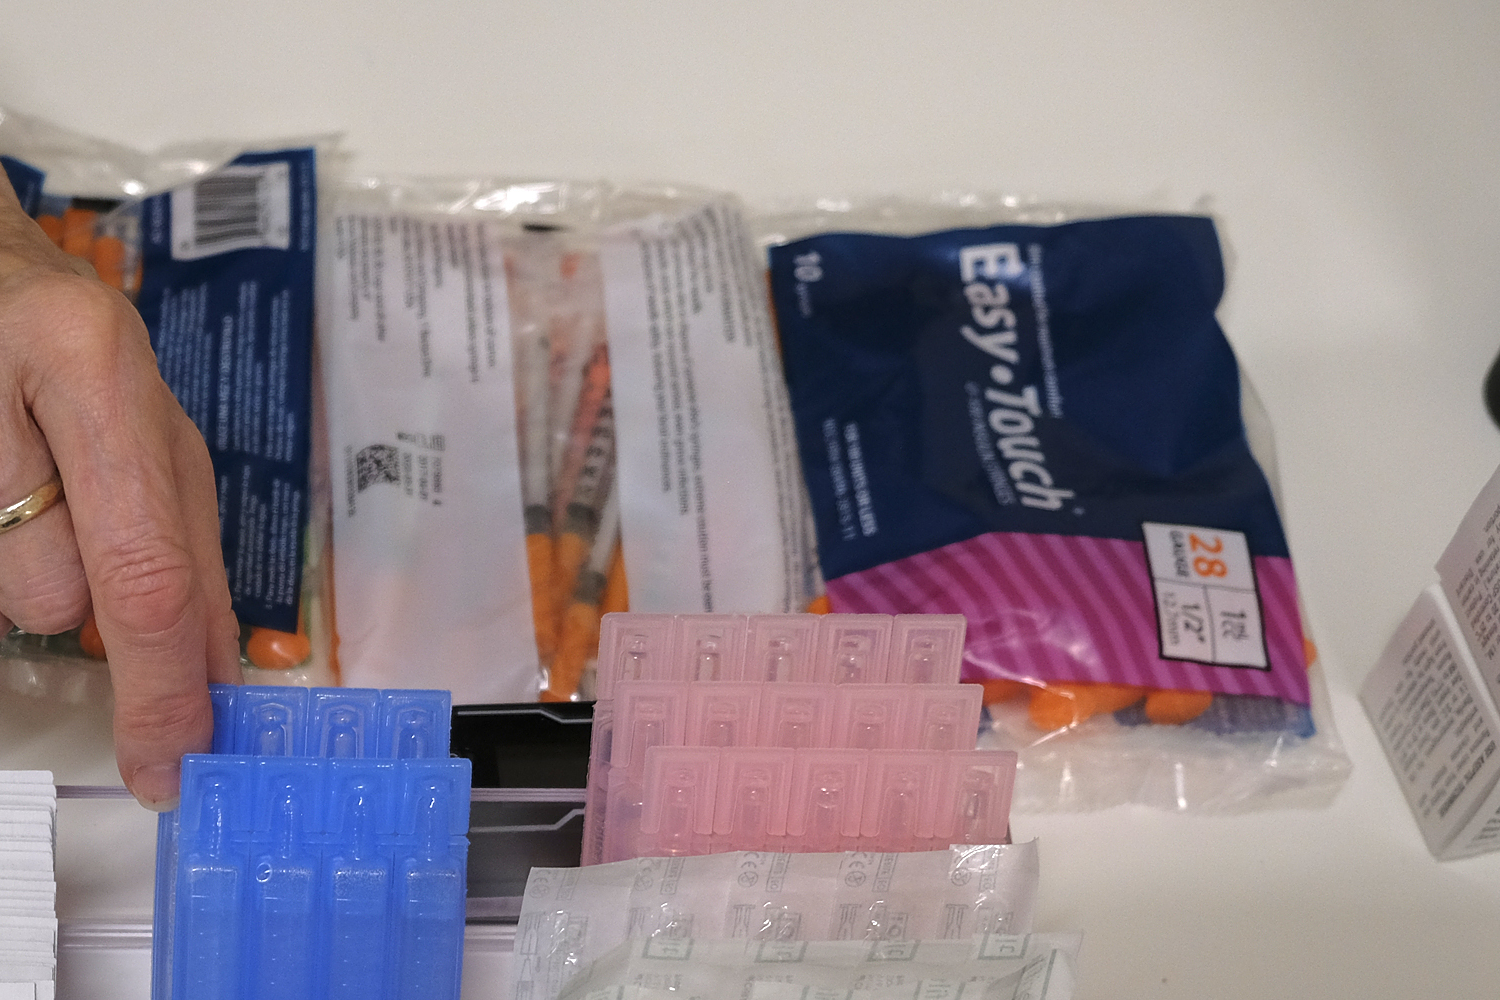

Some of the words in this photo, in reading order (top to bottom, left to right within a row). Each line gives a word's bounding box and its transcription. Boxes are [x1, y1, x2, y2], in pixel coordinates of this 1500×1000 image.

[794, 251, 823, 282] 10
[960, 242, 1026, 369] Easy
[986, 385, 1076, 513] Touch
[1188, 529, 1229, 582] 28
